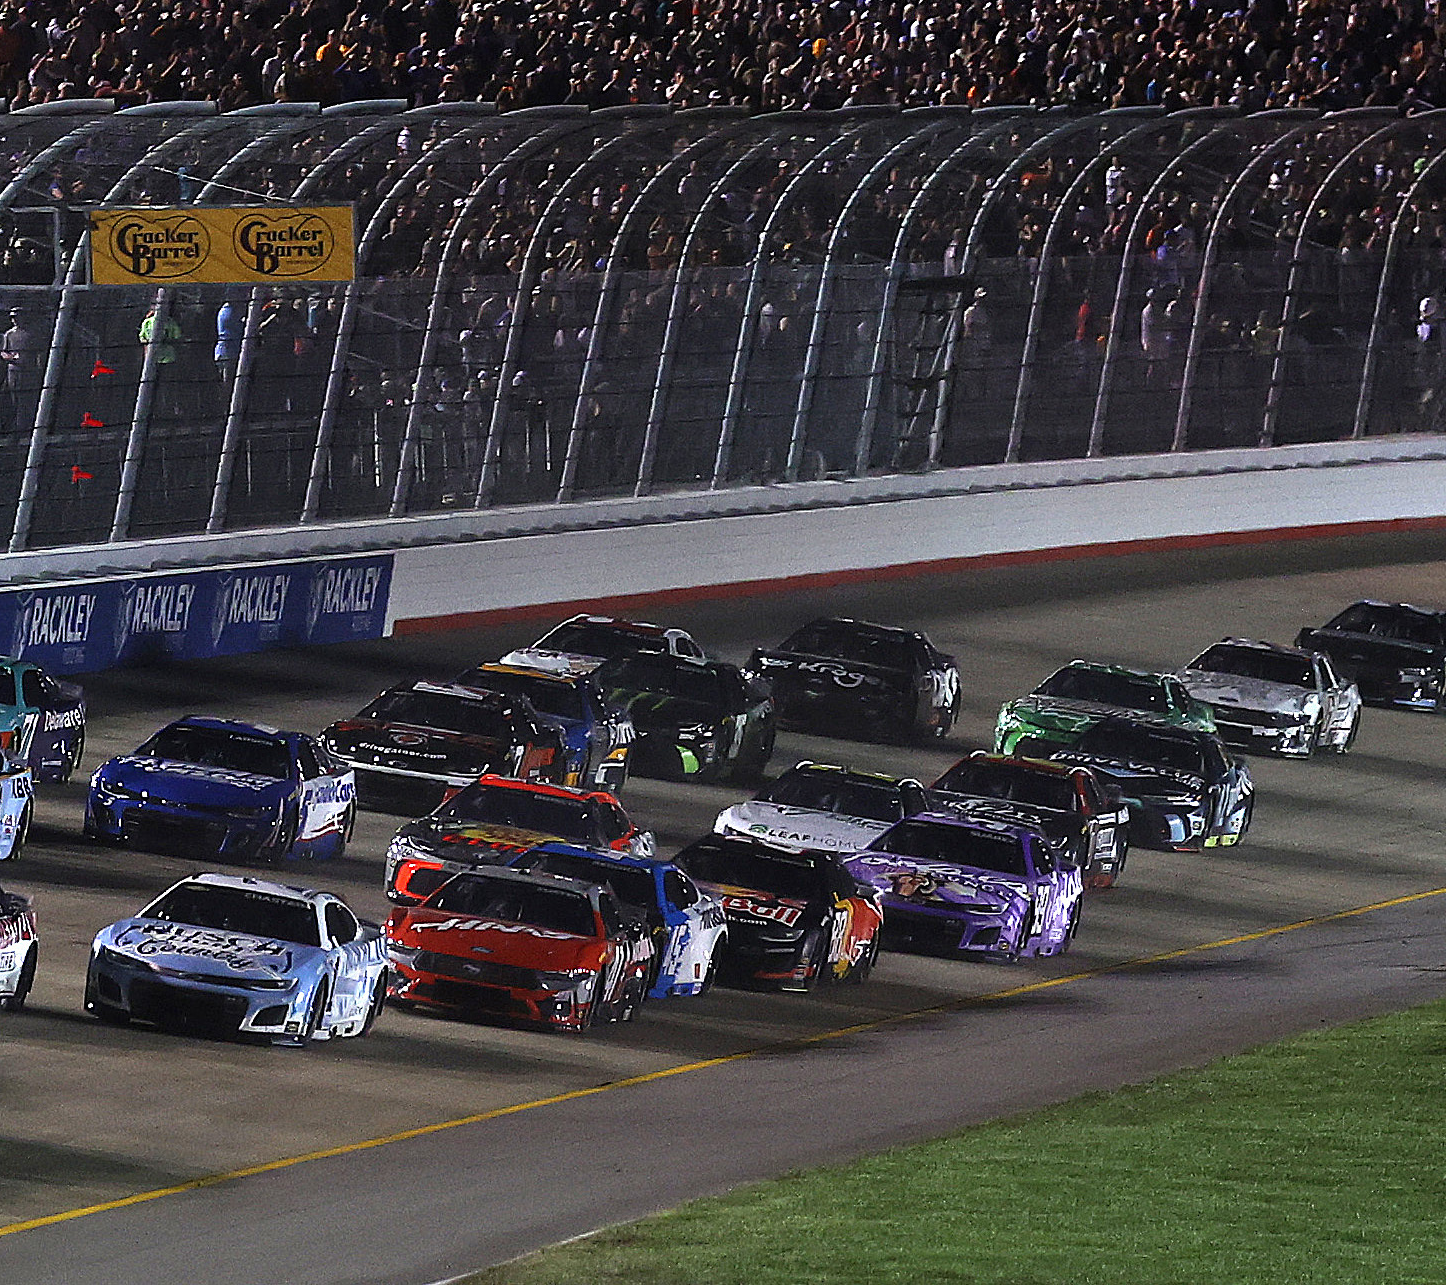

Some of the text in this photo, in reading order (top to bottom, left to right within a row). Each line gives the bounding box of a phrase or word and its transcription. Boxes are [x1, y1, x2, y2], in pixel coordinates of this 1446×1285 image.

[117, 223, 199, 258] Cracker
[240, 221, 323, 255] Cracker
[132, 242, 200, 275] Barrel
[256, 240, 324, 274] Barrel
[228, 574, 292, 624] RACKLEY
[322, 565, 383, 614] RACKLEY
[29, 594, 97, 647] RACKLEY
[131, 584, 197, 635] RACKLEY
[722, 895, 803, 927] Bull
